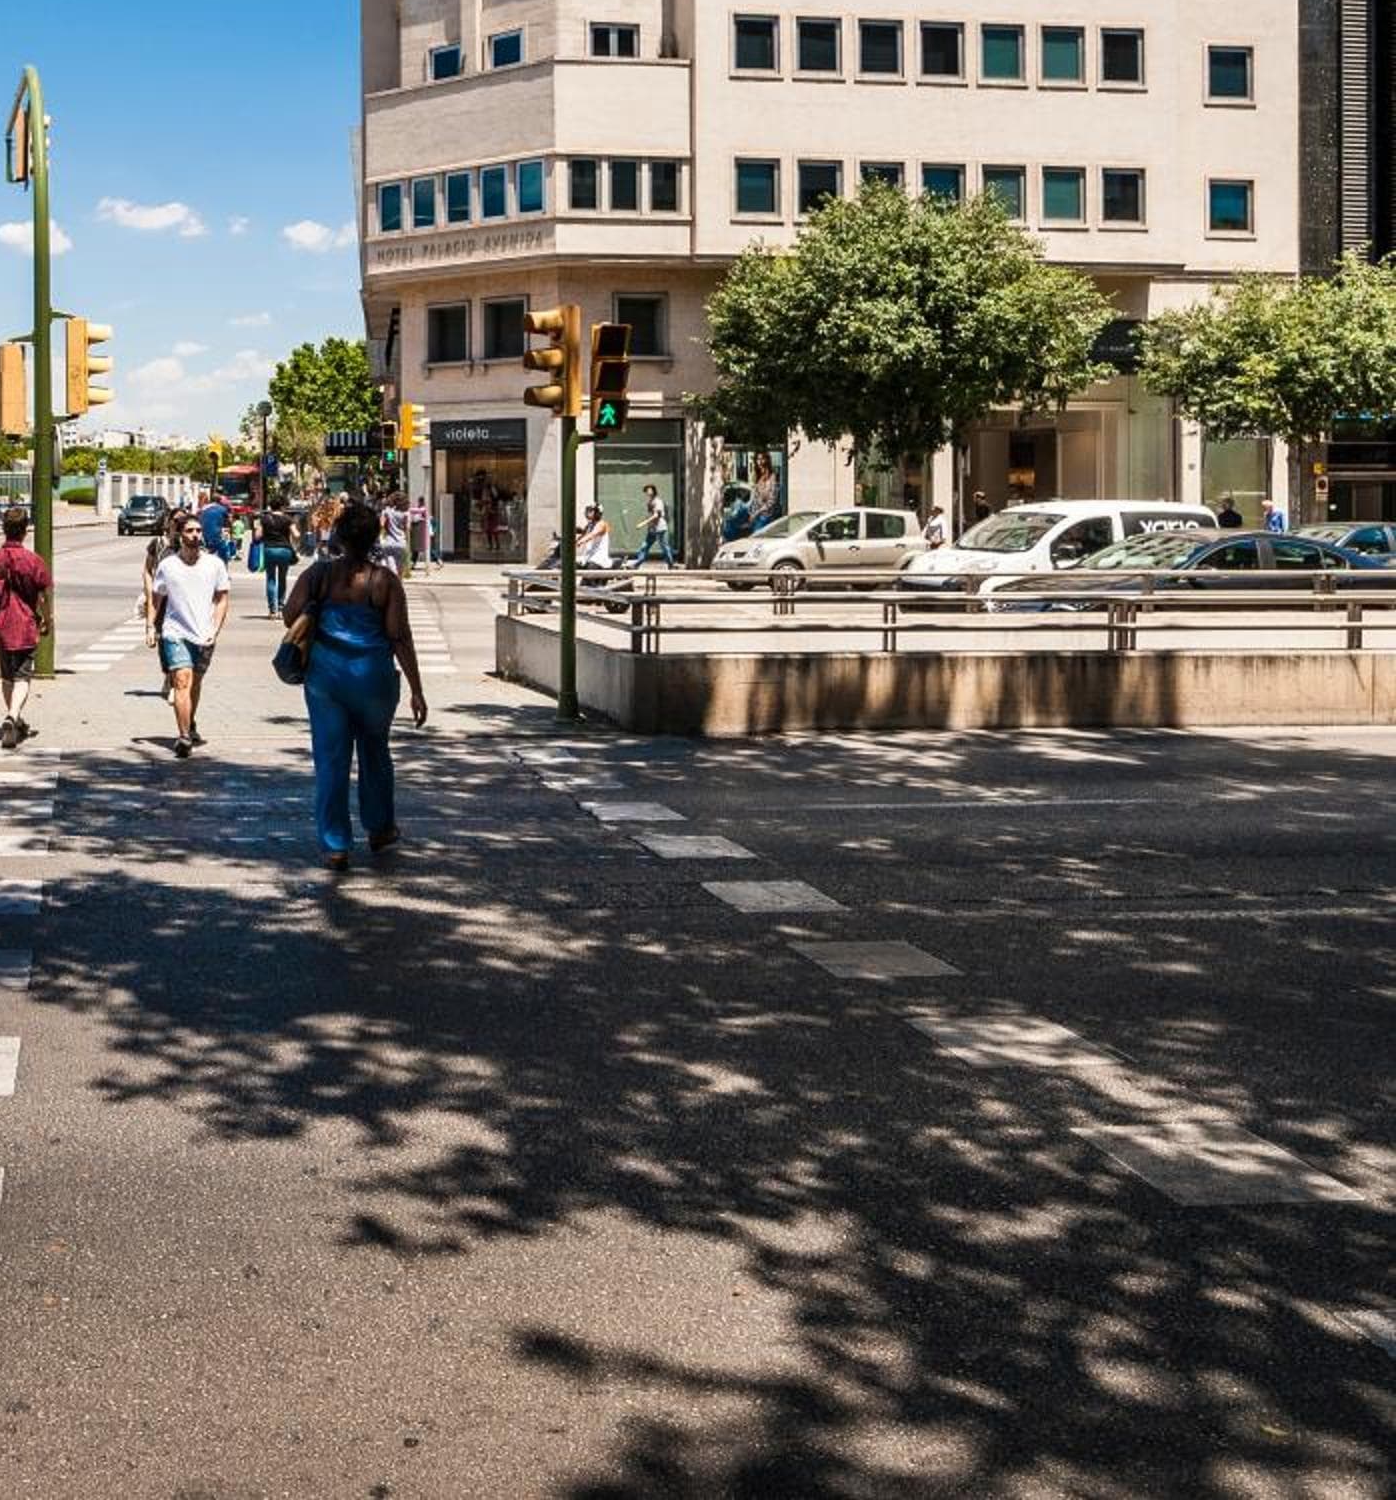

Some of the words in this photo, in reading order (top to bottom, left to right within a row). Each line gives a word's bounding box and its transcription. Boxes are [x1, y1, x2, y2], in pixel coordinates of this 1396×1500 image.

[377, 246, 413, 266] HOTEL
[423, 238, 477, 260] PALACIO
[485, 230, 542, 253] AVENIDA
[444, 427, 489, 441] violeta
